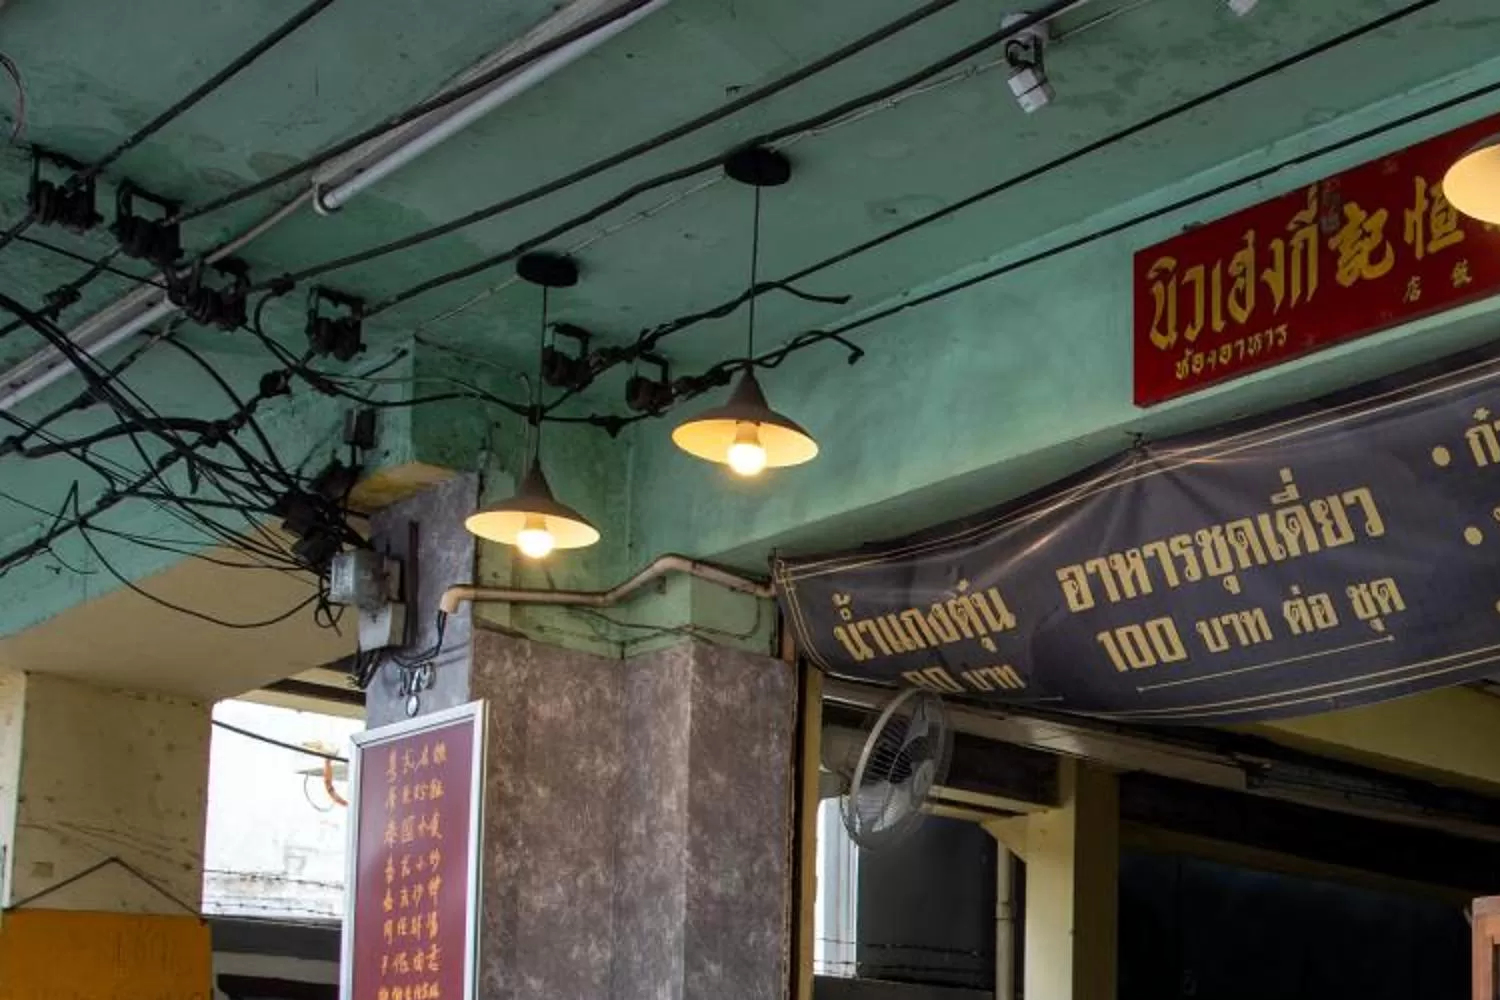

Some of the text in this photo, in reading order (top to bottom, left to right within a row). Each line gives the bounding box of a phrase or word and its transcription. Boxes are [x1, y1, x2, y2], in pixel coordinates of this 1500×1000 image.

[1174, 323, 1289, 380] ห้องอาหาร
[1055, 466, 1386, 614] อาหารชุดเดี่ยว
[832, 578, 1018, 663] น้ำแกงตุ๋น
[1096, 576, 1407, 673] 100 บาท ต่อ ชุด
[960, 663, 1028, 692] บาท
